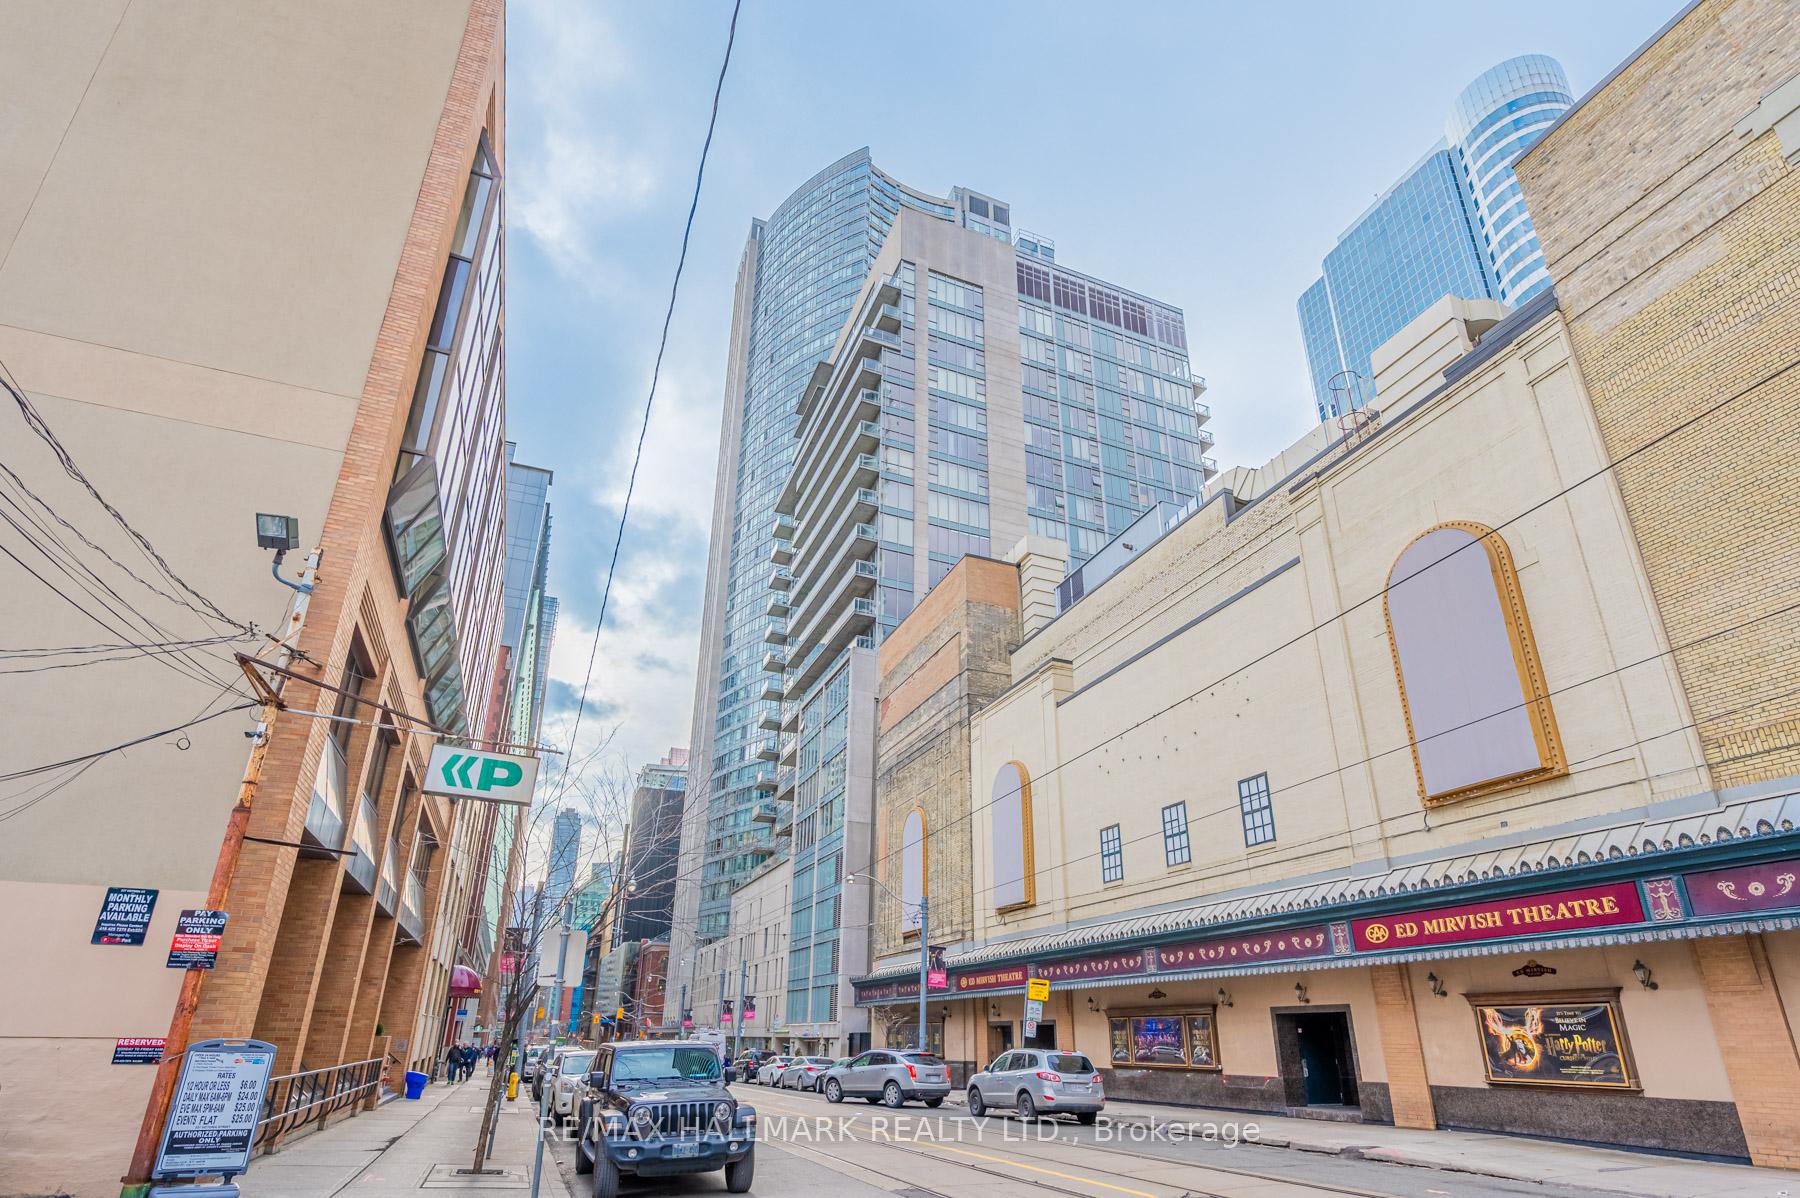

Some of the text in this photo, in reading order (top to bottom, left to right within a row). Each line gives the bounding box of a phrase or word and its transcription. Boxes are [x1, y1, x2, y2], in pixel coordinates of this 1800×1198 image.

[477, 758, 523, 792] P
[108, 893, 153, 903] MONTHLY
[107, 903, 148, 913] PARKING
[100, 912, 150, 922] AVAILABLE
[180, 917, 225, 925] PARKING
[1394, 922, 1419, 939] ED
[1423, 911, 1502, 935] MIRVISH
[1506, 896, 1619, 925] THEATRE
[976, 975, 996, 985] MIRVISH
[998, 971, 1023, 983] THEATRE
[1545, 1034, 1606, 1056] Harry Potter
[194, 1081, 208, 1090] HOUR
[209, 1081, 217, 1090] OR
[217, 1081, 231, 1090] LESS
[240, 1080, 257, 1090] $6.00
[183, 1092, 198, 1102] DAILY
[199, 1092, 210, 1101] MAX
[237, 1091, 258, 1101] $24.00
[180, 1103, 191, 1113] EVE
[191, 1103, 202, 1113] MAX
[234, 1103, 255, 1112] $25.00
[176, 1114, 253, 1125] EVENTS FLAT $25.00
